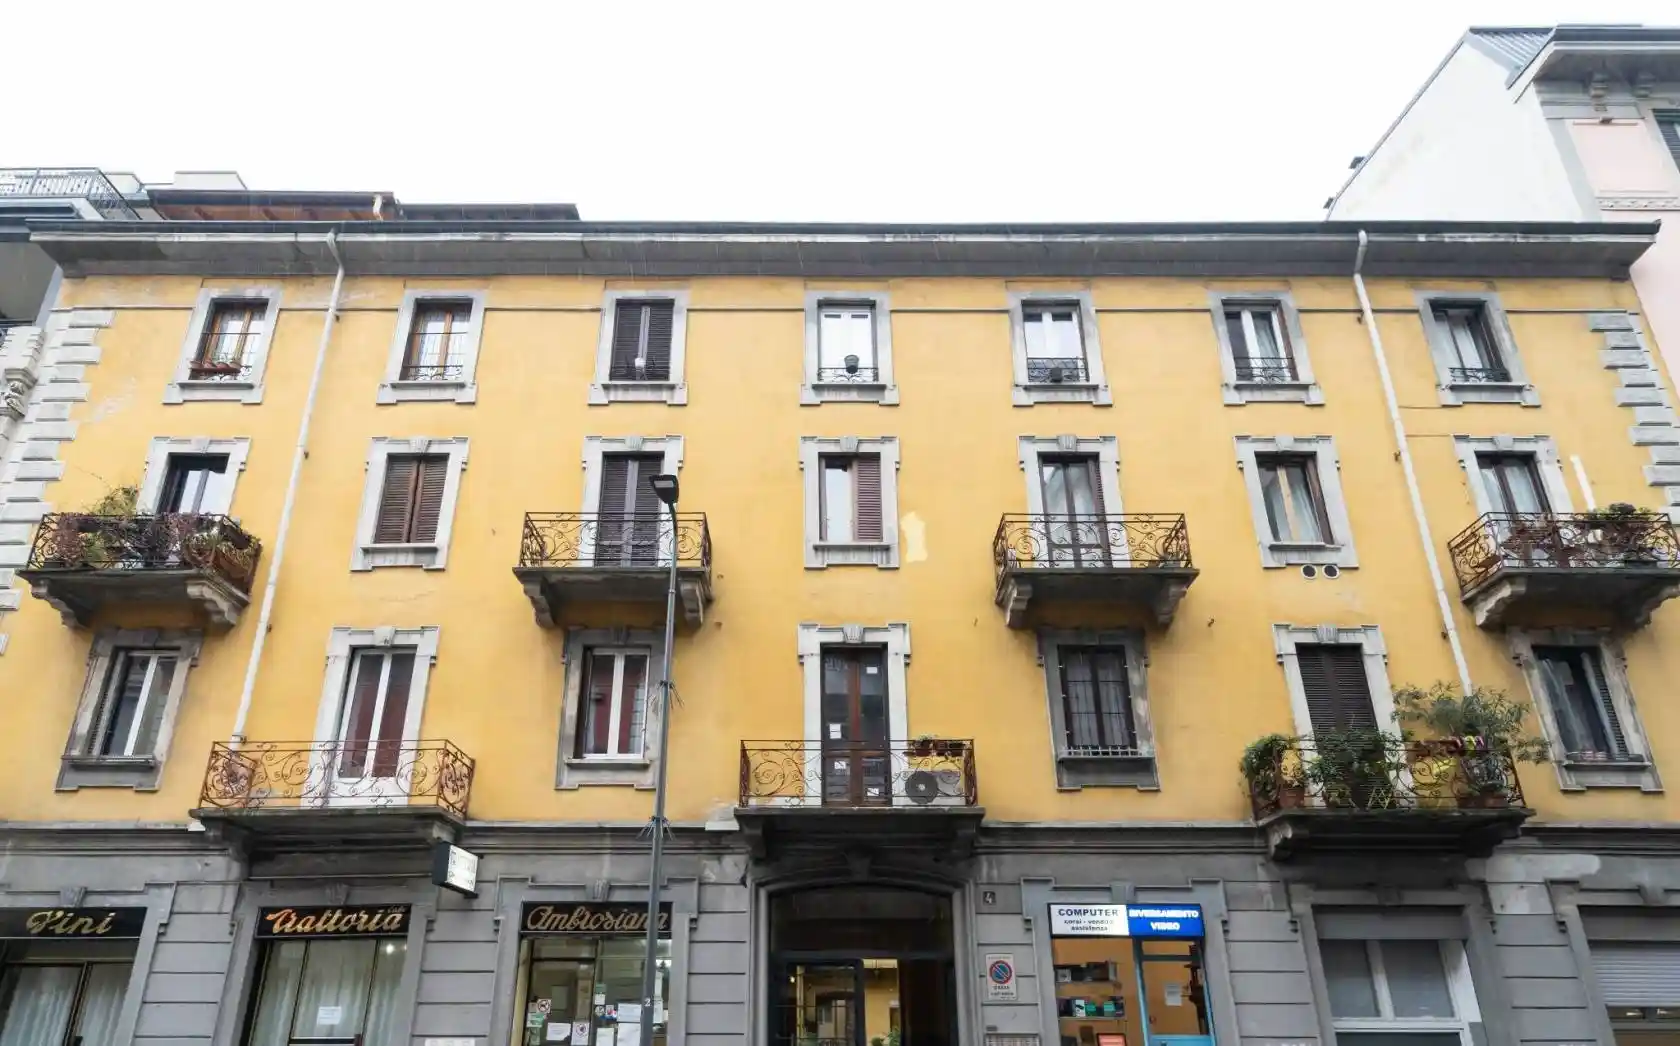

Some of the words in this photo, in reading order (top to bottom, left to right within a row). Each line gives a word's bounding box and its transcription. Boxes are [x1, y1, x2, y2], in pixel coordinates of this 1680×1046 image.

[26, 910, 116, 934] Vini
[265, 908, 403, 934] Trattoria
[527, 905, 668, 931] Ambrosiana
[1058, 908, 1119, 917] COMPUTER
